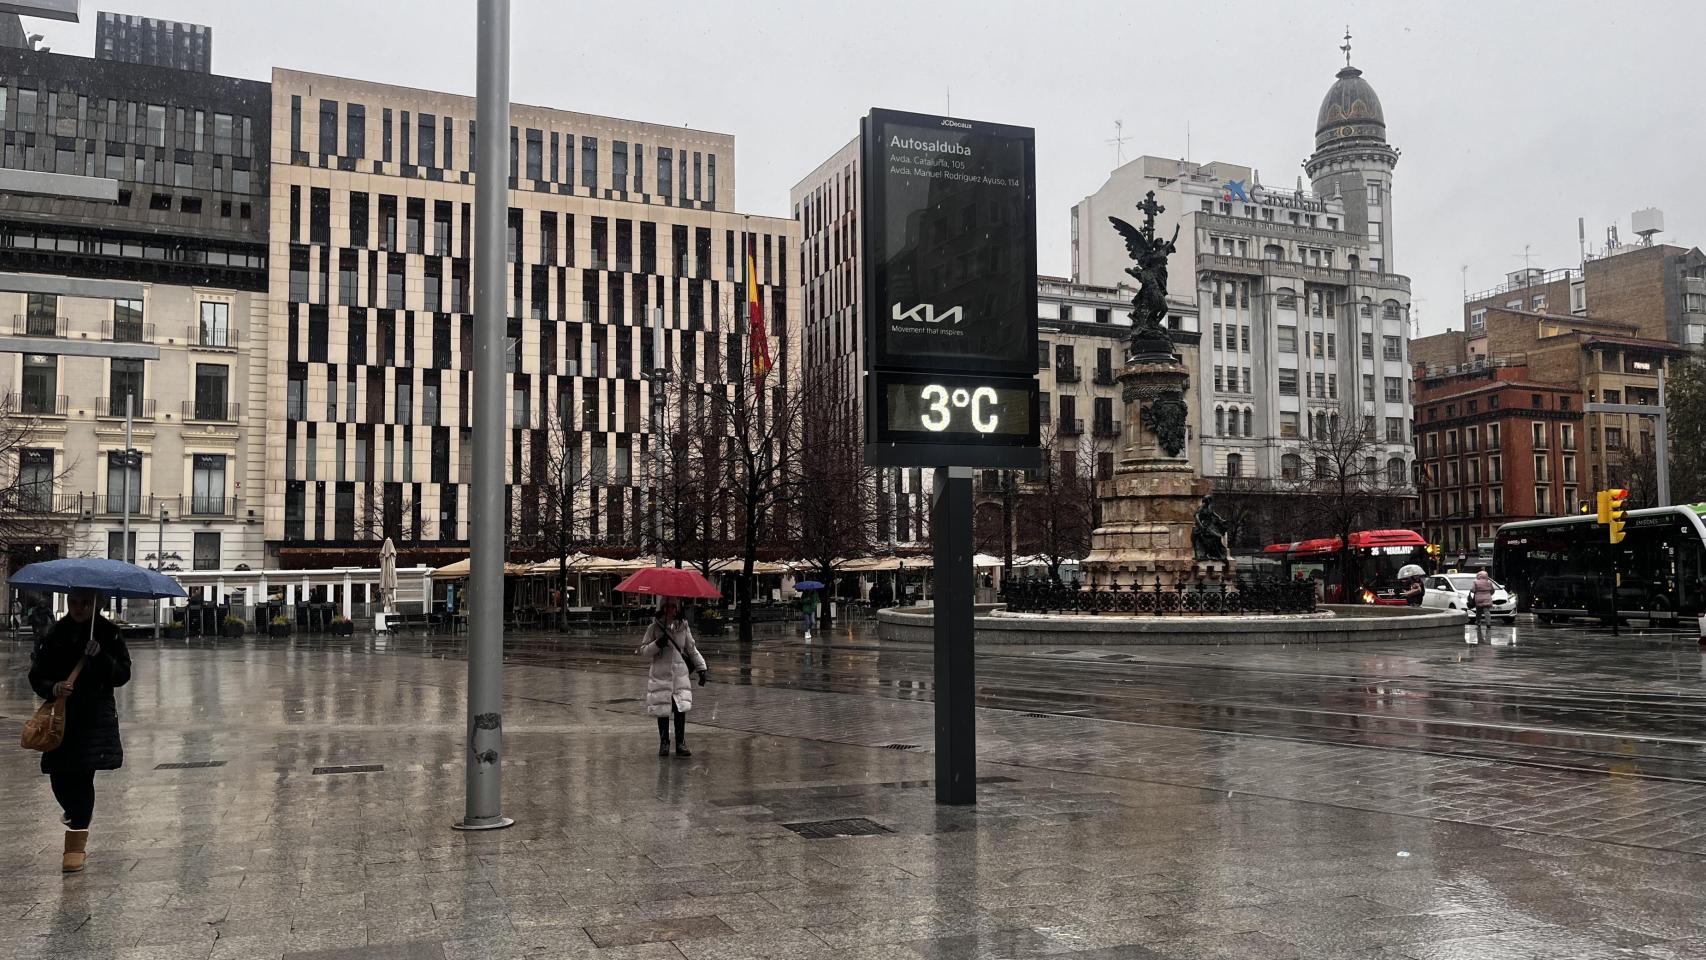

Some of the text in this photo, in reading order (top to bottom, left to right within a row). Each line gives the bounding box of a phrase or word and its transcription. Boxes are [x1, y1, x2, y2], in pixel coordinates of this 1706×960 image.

[940, 120, 972, 129] JCDecaux
[890, 135, 972, 156] Autosalduba
[890, 154, 910, 164] Avda.
[952, 160, 965, 170] 105
[890, 165, 911, 175] Avda.
[914, 168, 942, 178] Manuel
[1008, 179, 1019, 187] 114
[1249, 184, 1327, 213] CaixaBank
[892, 325, 925, 334] Movement
[926, 326, 939, 335] that
